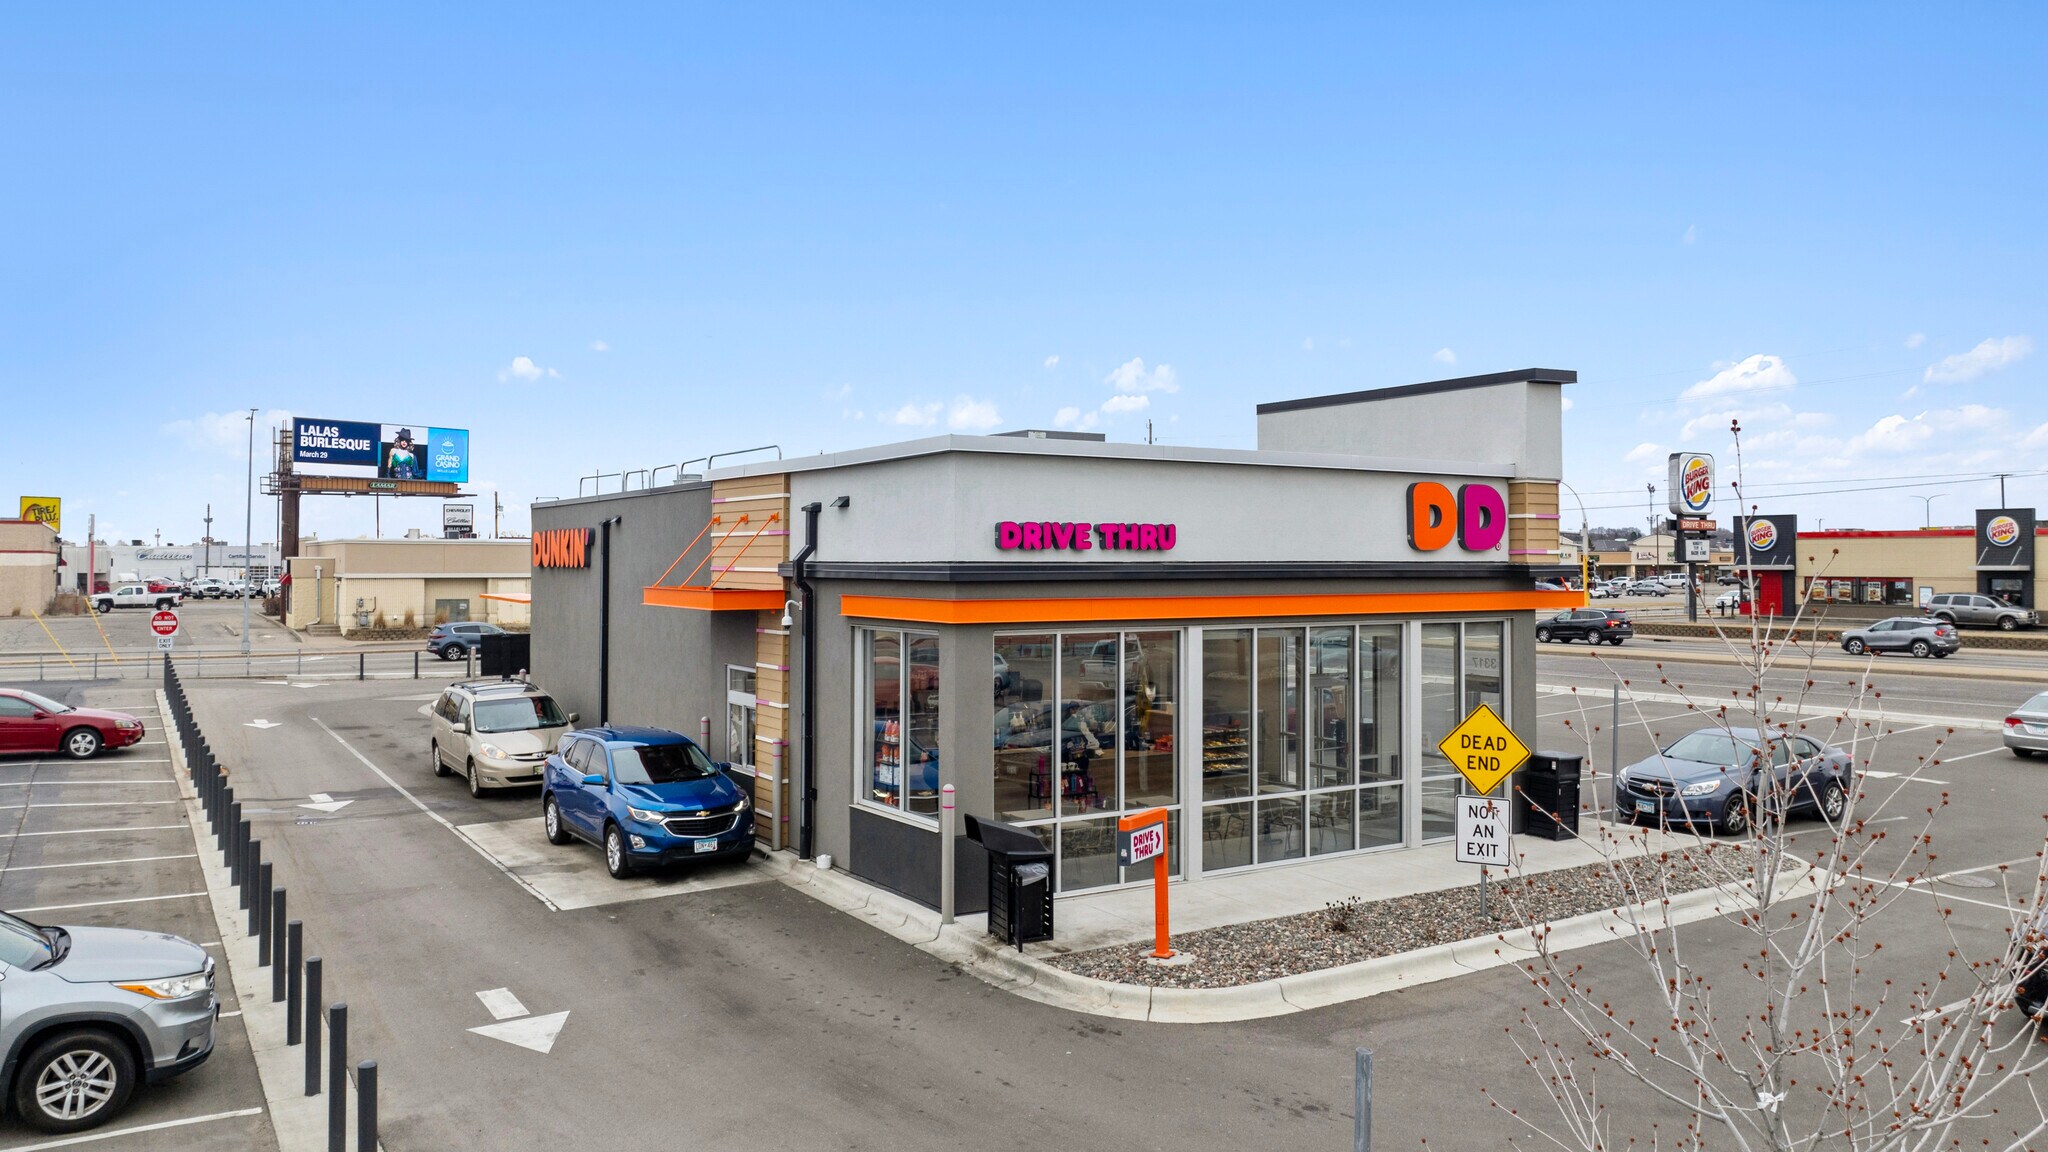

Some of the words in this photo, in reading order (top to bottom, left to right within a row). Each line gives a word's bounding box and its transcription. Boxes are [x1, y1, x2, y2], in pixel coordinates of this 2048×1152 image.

[300, 424, 339, 438] LALAS
[300, 436, 371, 451] BURLESQUE
[299, 450, 319, 459] March
[320, 451, 328, 459] 29
[435, 454, 460, 462] GRAND
[435, 460, 461, 469] CASINO
[1685, 465, 1709, 485] BURGER
[1685, 476, 1710, 500] KING
[32, 504, 57, 516] TIRES
[1682, 521, 1699, 529] DRIVE
[1701, 521, 1716, 530] THRU
[1750, 525, 1772, 537] BURGER
[1990, 522, 2014, 532] BURGER
[1991, 527, 2015, 539] KING
[997, 521, 1093, 550] DRIVE
[1096, 522, 1176, 550] THRU
[1751, 530, 1773, 544] KING
[1461, 734, 1508, 752] DEAD
[1467, 755, 1501, 772] END
[1468, 804, 1499, 820] NOT
[1133, 829, 1154, 848] DRIVE
[1472, 824, 1495, 839] AN
[1134, 842, 1154, 860] THRU
[1466, 842, 1499, 858] EXIT
